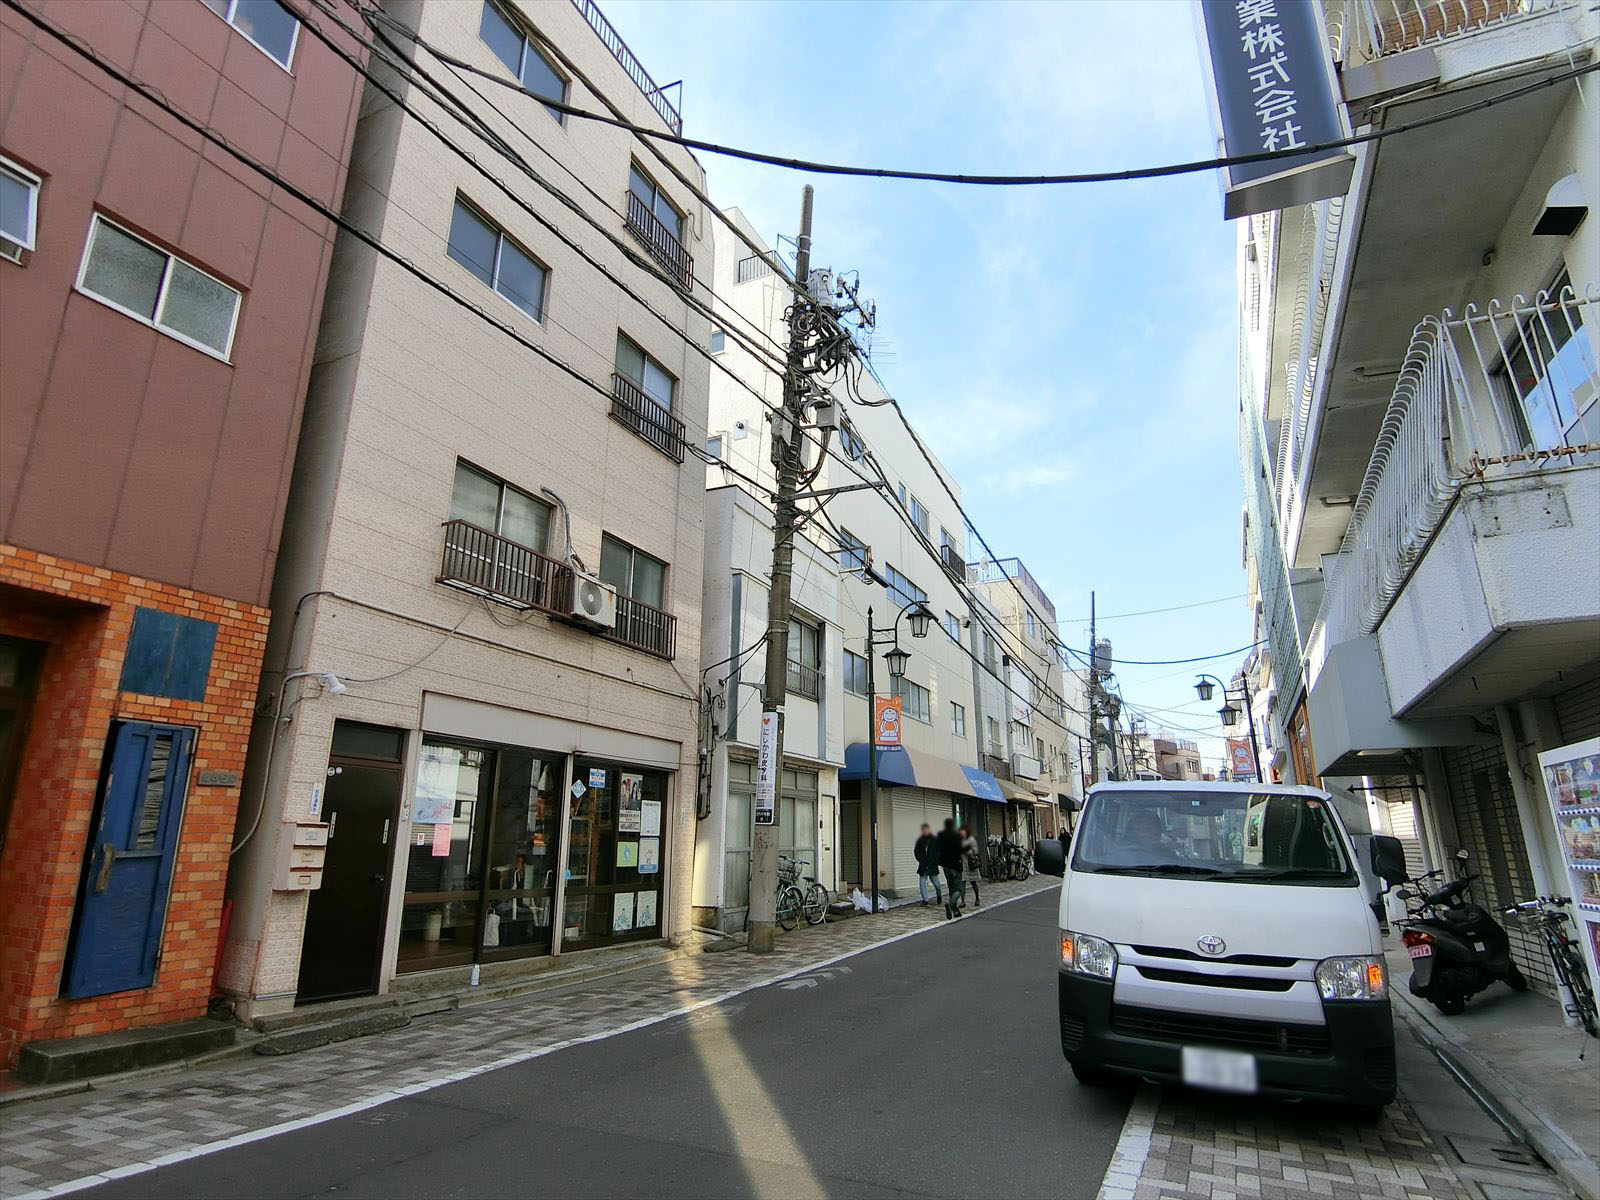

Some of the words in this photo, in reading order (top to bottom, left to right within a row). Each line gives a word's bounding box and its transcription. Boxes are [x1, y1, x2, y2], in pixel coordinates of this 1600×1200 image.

[1235, 0, 1306, 152] 業株式会社
